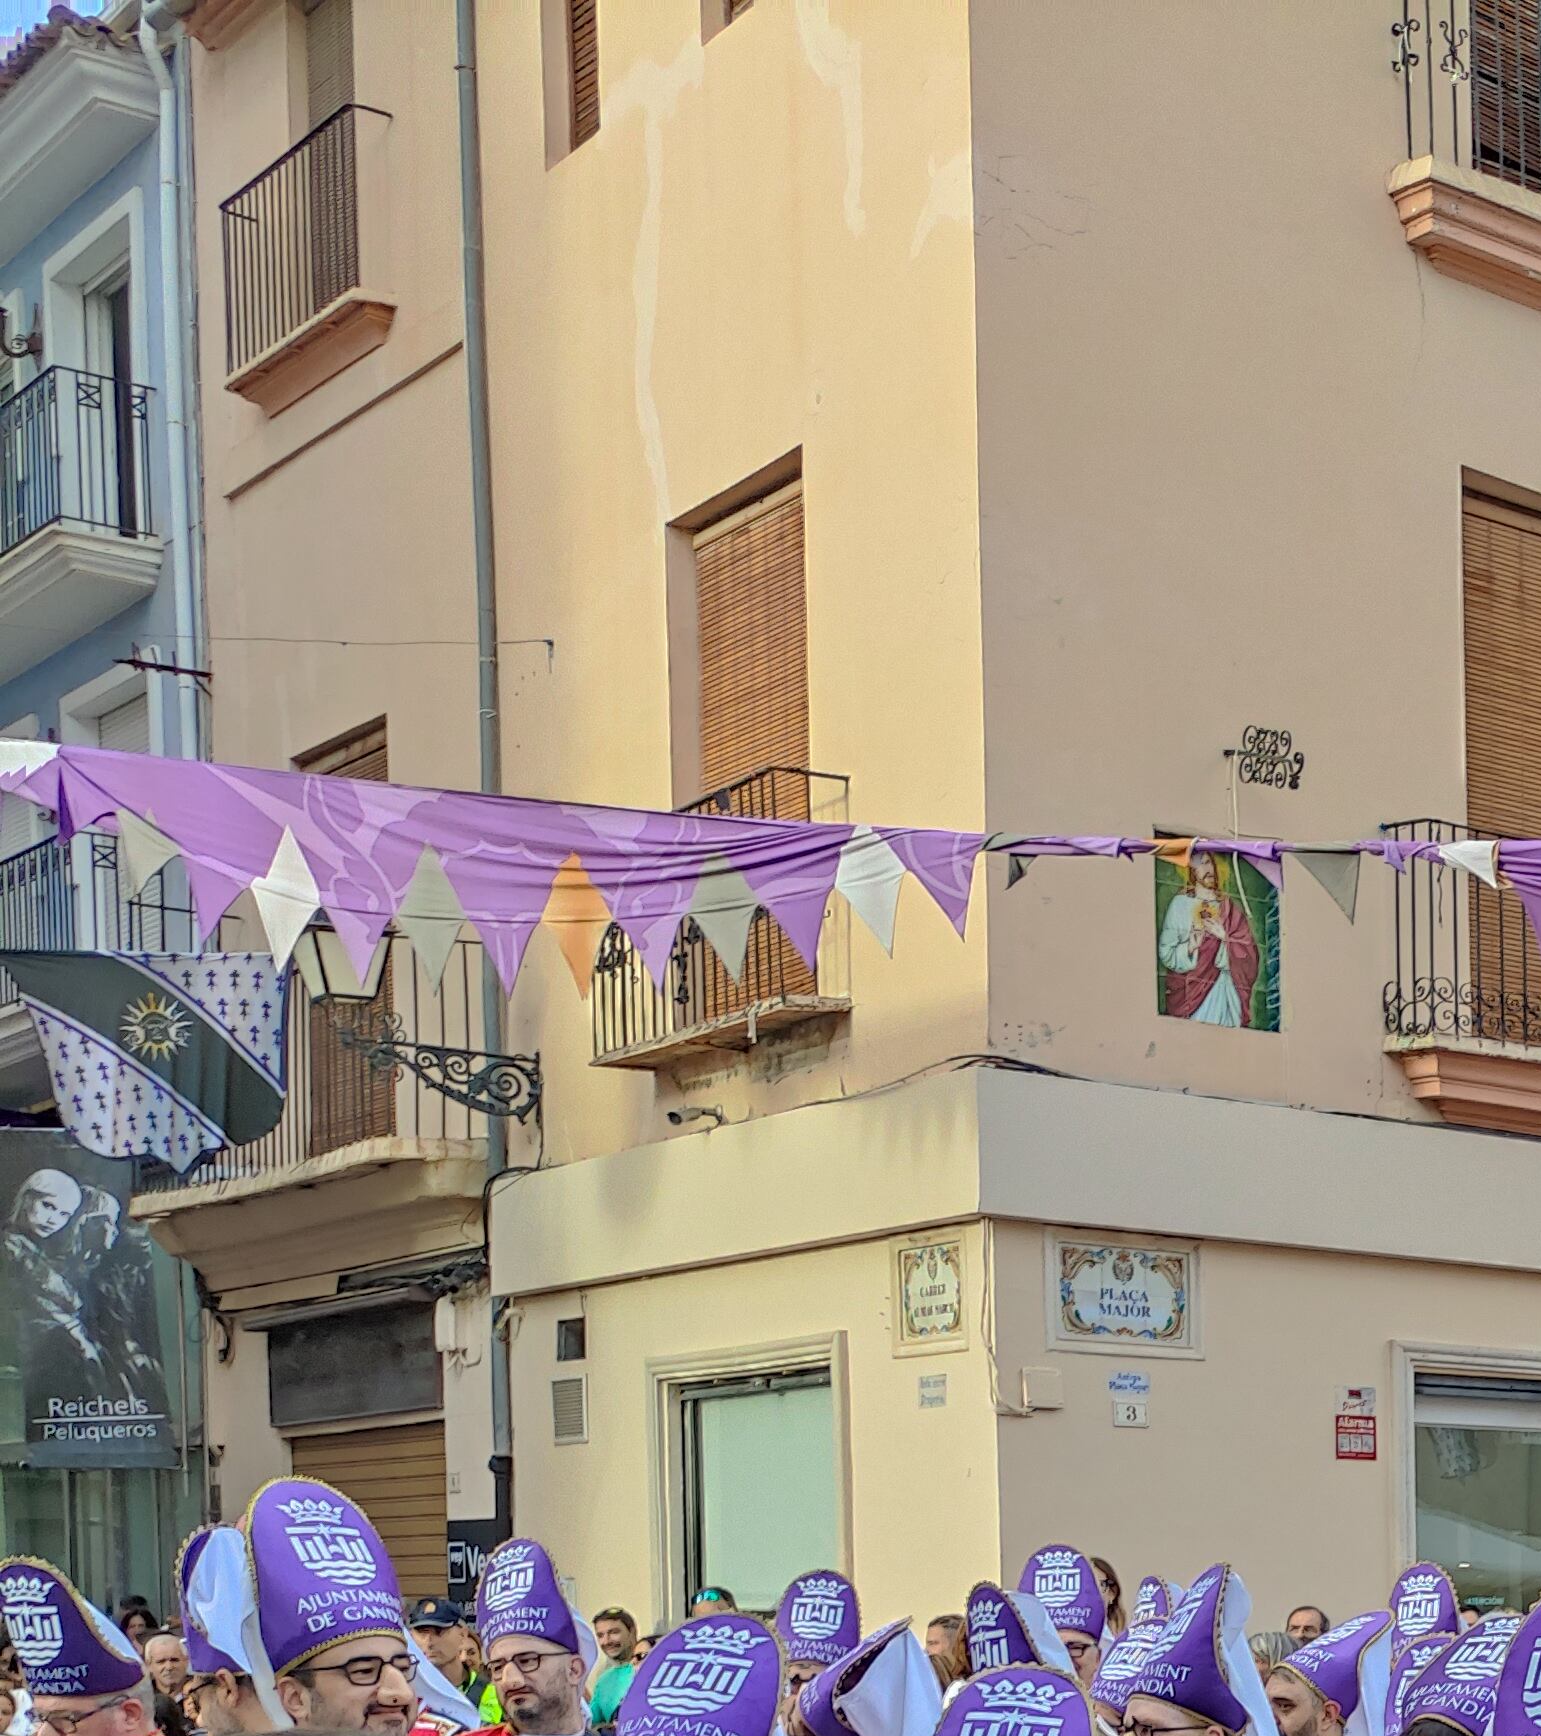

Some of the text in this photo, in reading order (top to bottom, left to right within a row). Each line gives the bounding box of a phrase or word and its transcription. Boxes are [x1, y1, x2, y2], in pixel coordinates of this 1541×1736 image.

[1100, 1287, 1149, 1304] PLAÇA
[1099, 1302, 1151, 1318] MAJOR
[47, 1394, 149, 1418] Reichels
[1125, 1405, 1137, 1422] 3
[42, 1421, 157, 1444] Peluqueros
[306, 1615, 335, 1634] DE
[1409, 1682, 1498, 1707] AJUNTAMEN
[1422, 1695, 1496, 1724] GANDIA
